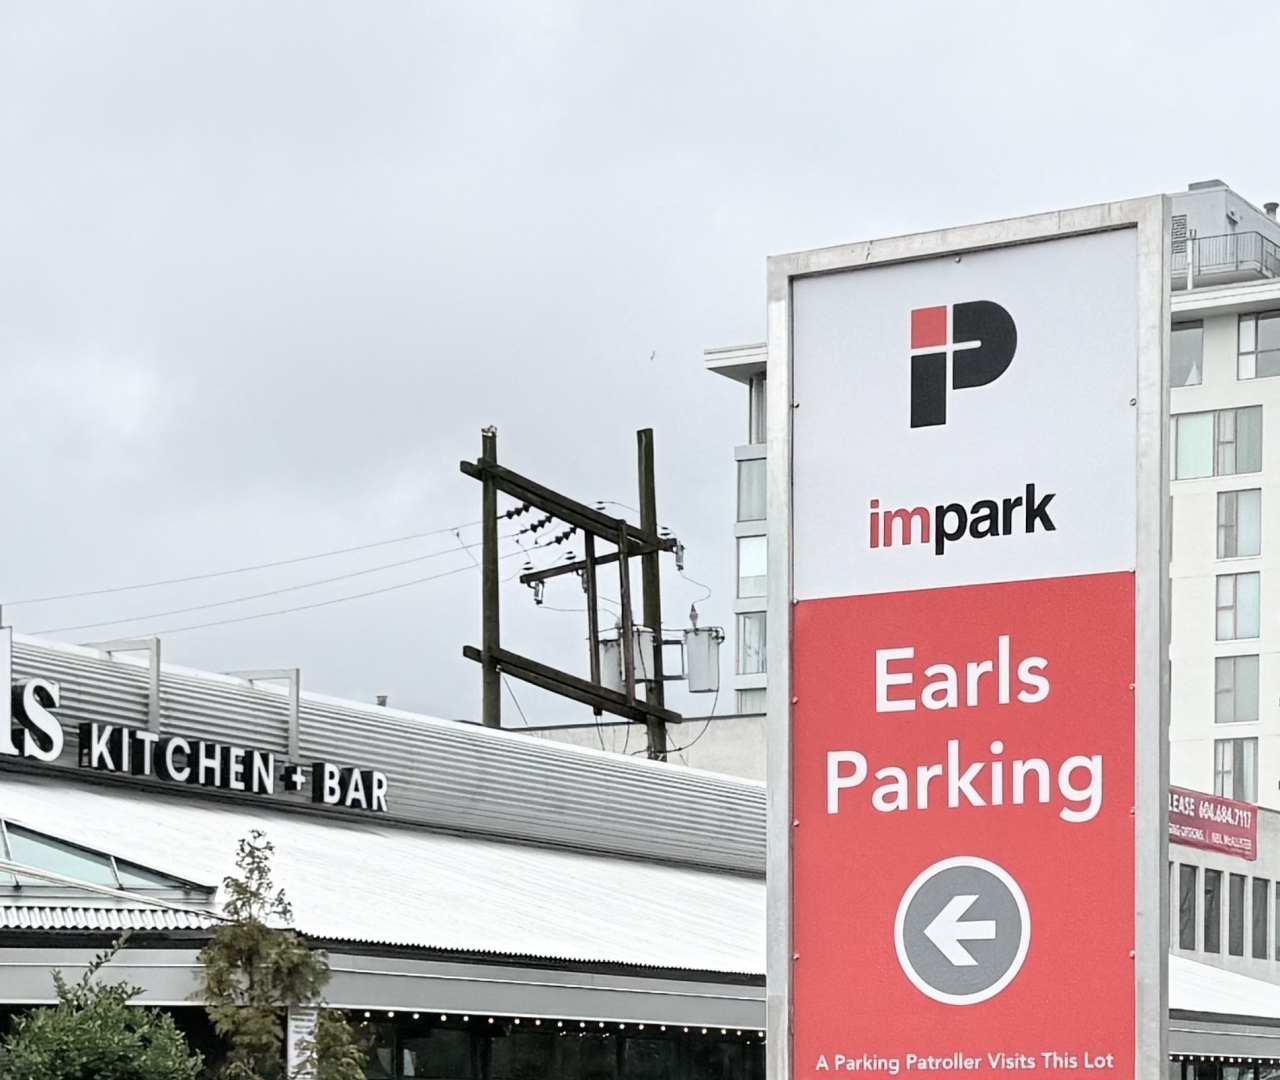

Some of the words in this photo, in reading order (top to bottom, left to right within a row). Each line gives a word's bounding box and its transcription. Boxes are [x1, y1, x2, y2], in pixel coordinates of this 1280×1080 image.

[869, 482, 1057, 556] impark
[875, 634, 1051, 713] Earls
[78, 721, 275, 796] KITCHEN
[312, 762, 389, 813] BAR
[826, 739, 1103, 823] Parking
[815, 1054, 829, 1071] A
[834, 1053, 900, 1075] Parking
[906, 1052, 982, 1070] Patroller
[987, 1051, 1036, 1069] Visits
[1041, 1051, 1078, 1069] This
[1084, 1051, 1114, 1069] Lot
